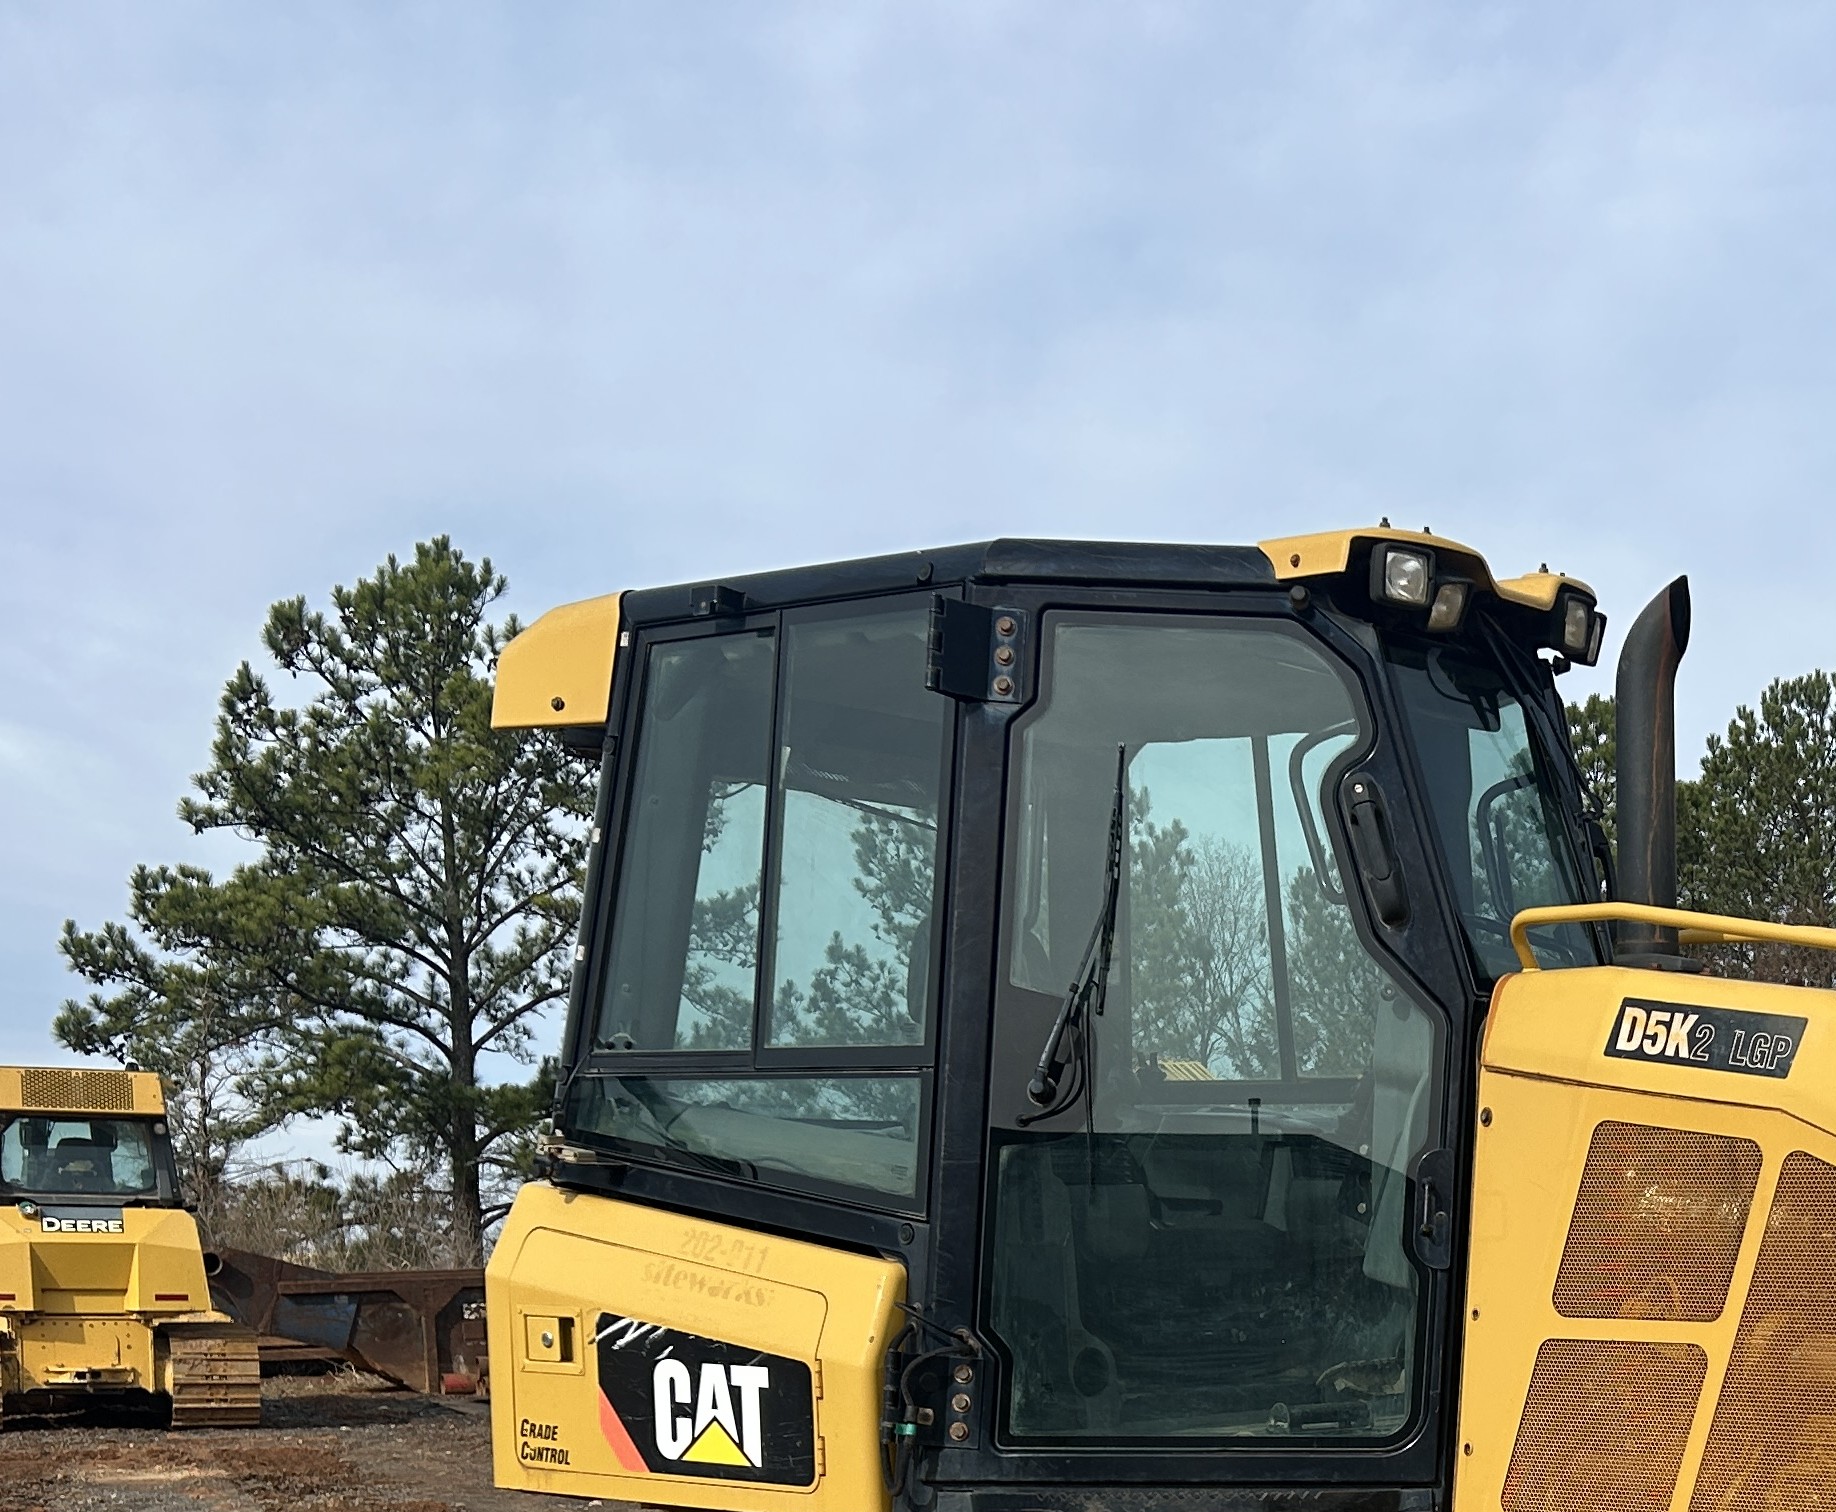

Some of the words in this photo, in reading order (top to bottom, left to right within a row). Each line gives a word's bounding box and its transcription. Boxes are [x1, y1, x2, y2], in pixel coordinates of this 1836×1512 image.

[1615, 1006, 1715, 1062] D5K2
[1728, 1029, 1793, 1070] LGP
[42, 1216, 123, 1233] DEERE
[653, 1358, 770, 1468] CAT
[520, 1418, 559, 1442] GRADE
[520, 1441, 571, 1466] CONTROL
